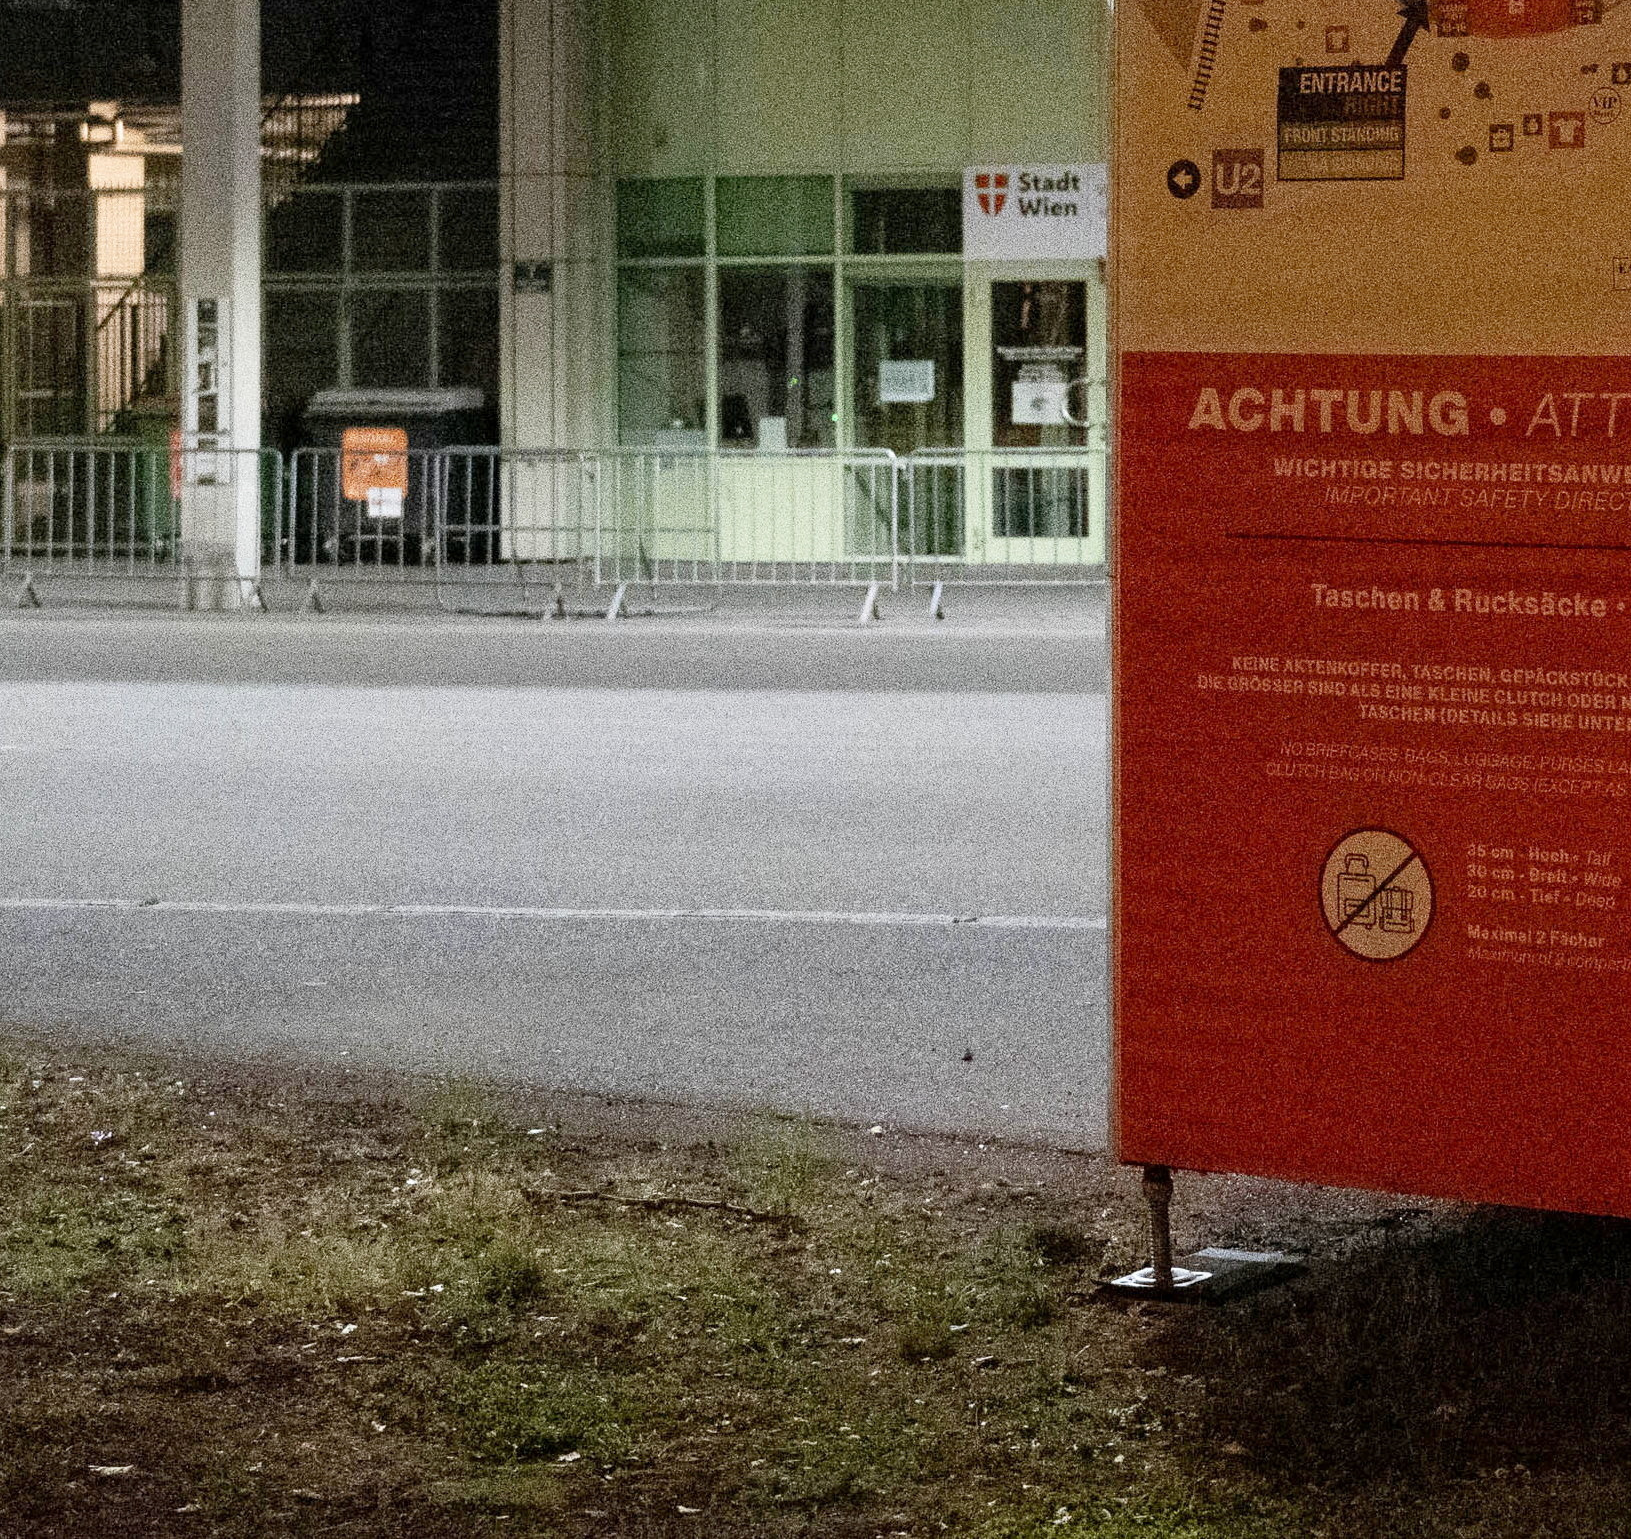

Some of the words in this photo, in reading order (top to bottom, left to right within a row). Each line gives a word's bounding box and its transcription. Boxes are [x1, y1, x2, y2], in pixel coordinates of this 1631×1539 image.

[1300, 70, 1402, 94] ENTRANCE
[1018, 171, 1080, 192] Stadt
[1217, 162, 1263, 195] U2
[1018, 196, 1078, 218] Wien
[1188, 387, 1469, 436] ACHTUNG
[1274, 458, 1393, 480] WICHTIGE
[1325, 485, 1454, 506] IMPORTANT
[1460, 487, 1549, 509] SAFETY
[1312, 583, 1419, 611] Taschen
[1427, 588, 1446, 612] &
[1454, 589, 1607, 618] Rucksäcke
[1232, 656, 1279, 672] KEINE
[1284, 659, 1408, 680] AKTENKOFFER,
[1198, 674, 1225, 691] DIE
[1227, 675, 1304, 695] GRÖSSER
[1308, 680, 1346, 697] SIND
[1350, 681, 1381, 699] ALS
[1385, 683, 1424, 701] EINE
[1428, 685, 1490, 704] KLEINE
[1494, 688, 1563, 707] CLUTCH
[1567, 692, 1616, 710] ODER
[1360, 704, 1436, 722] TASCHEN
[1439, 706, 1518, 726] (DETAILS
[1522, 712, 1574, 730] SIEHE
[1468, 843, 1486, 858] 35
[1490, 847, 1515, 860] cm
[1467, 863, 1487, 879] 30
[1490, 868, 1515, 881] cm
[1468, 884, 1487, 899] 20
[1490, 888, 1515, 902] cm
[1468, 924, 1532, 944] Maximal
[1535, 930, 1547, 945] 2
